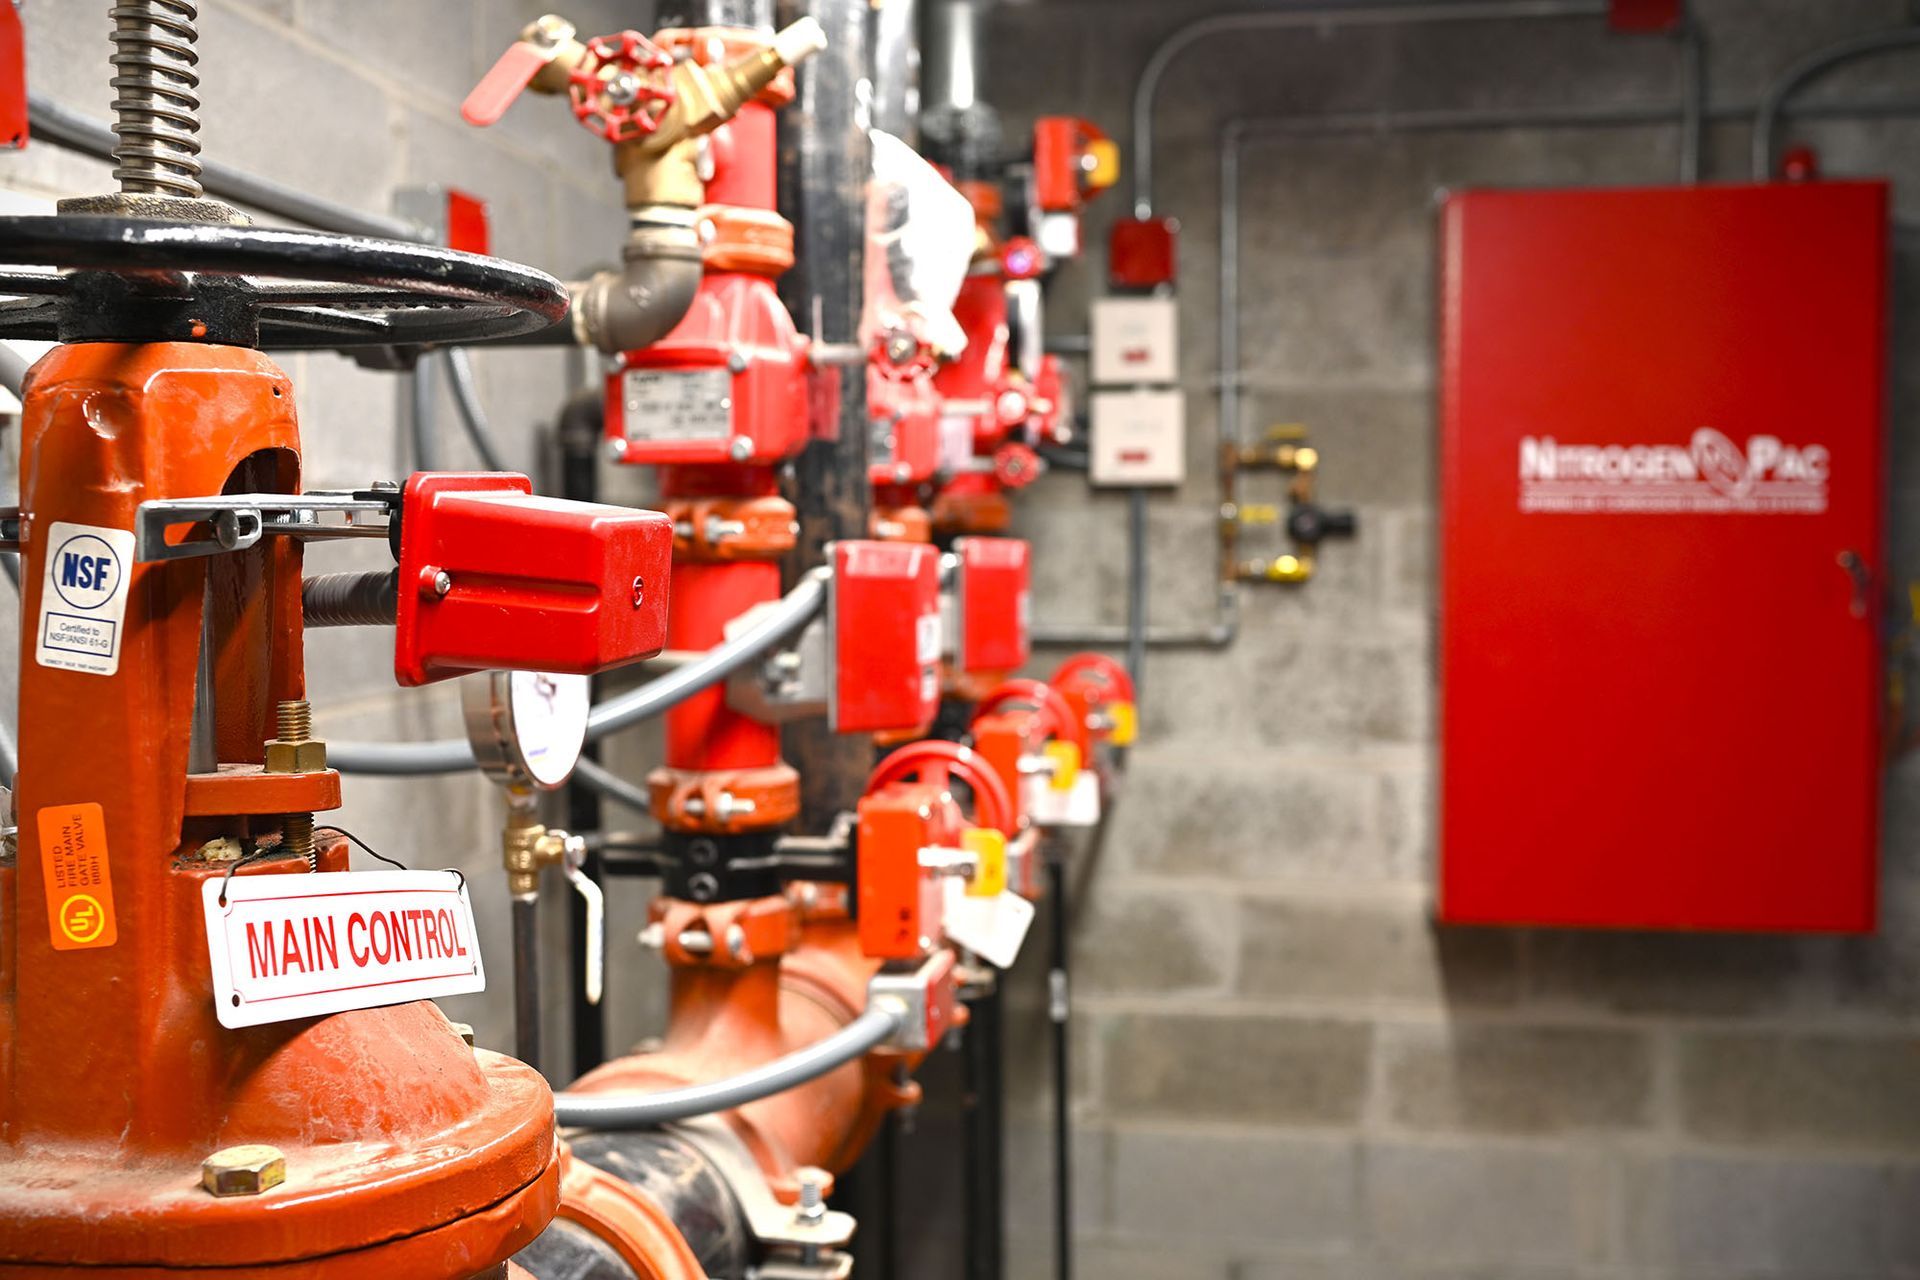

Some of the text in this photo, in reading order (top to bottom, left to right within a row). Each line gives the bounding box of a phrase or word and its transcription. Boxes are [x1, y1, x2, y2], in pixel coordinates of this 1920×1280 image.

[62, 552, 111, 591] NSF
[49, 632, 109, 649] NSF/ANSI 61-G
[60, 623, 100, 636] Certified to
[53, 845, 66, 889] LISTED
[62, 826, 77, 888] FIRE MAIN
[72, 814, 89, 887] GATE VALVE
[70, 905, 94, 931] UL
[246, 908, 466, 979] MAIN CONTROL
